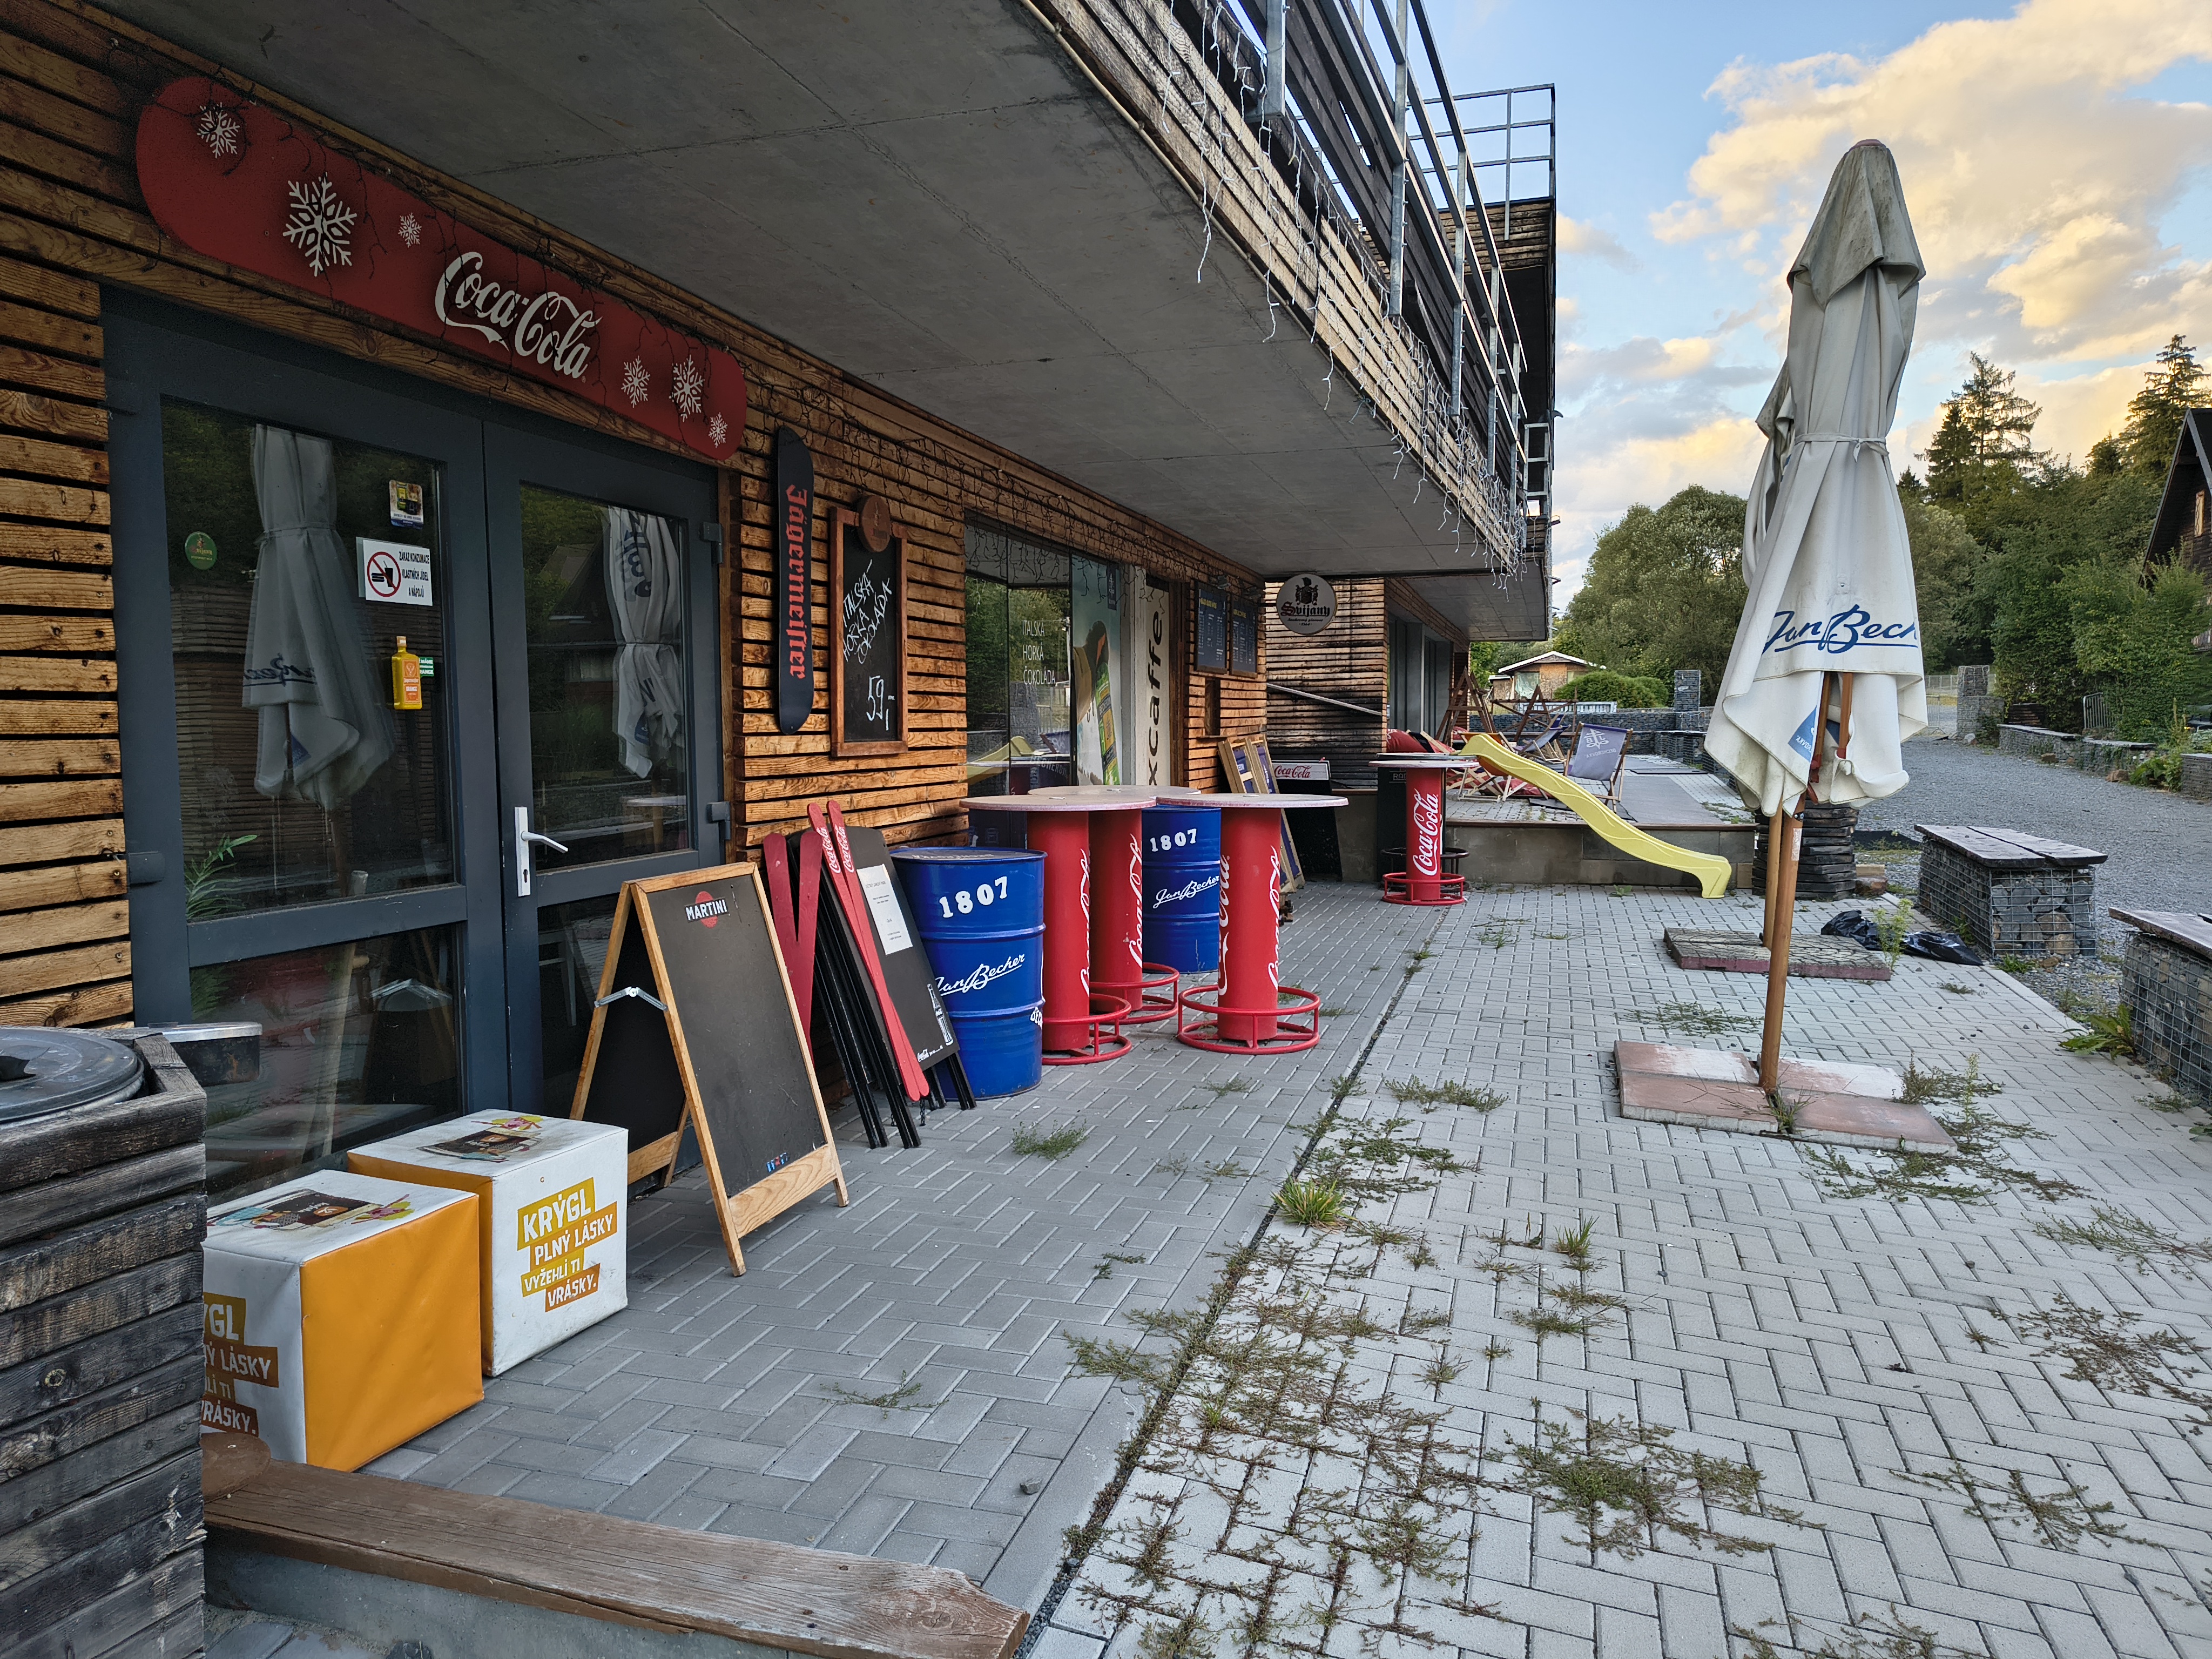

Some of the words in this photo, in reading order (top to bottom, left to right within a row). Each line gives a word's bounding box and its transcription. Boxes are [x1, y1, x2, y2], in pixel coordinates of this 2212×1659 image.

[435, 251, 603, 378] Coca-Cola
[399, 549, 410, 562] ZÁKAZ
[410, 552, 429, 564] KONZUMACE
[402, 568, 419, 580] VLASTNÍCH
[420, 569, 429, 581] JÍDEL
[409, 586, 412, 596] A
[412, 585, 424, 598] NÁPOJŮ
[786, 484, 807, 679] Jägermeister
[1280, 601, 1330, 617] Svijany
[1022, 618, 1045, 636] ITALSKÁ
[1023, 642, 1044, 660] HORKÁ
[1023, 665, 1056, 686] ČOKOLÁDA
[1274, 765, 1312, 778] Coca-Cola
[834, 824, 854, 873] Coca-Cola
[1150, 828, 1197, 852] 1807
[1413, 788, 1439, 876] Coca-Cola
[816, 826, 841, 873] Coca-Cola
[939, 876, 1008, 918] 1807
[1153, 888, 1181, 909] Jan
[1179, 875, 1219, 900] Becher
[685, 899, 727, 921] MARTINI
[963, 954, 1026, 993] Becher
[523, 1189, 591, 1243] KRÝGL
[535, 1229, 570, 1265] PLNÝ
[574, 1214, 613, 1247] LÁSKY
[524, 1259, 568, 1292] VYŽEHLÍ
[570, 1258, 581, 1274] TI
[547, 1273, 597, 1307] VRÁSKY.
[220, 1345, 271, 1380] LÁSKY
[219, 1380, 232, 1399] TI
